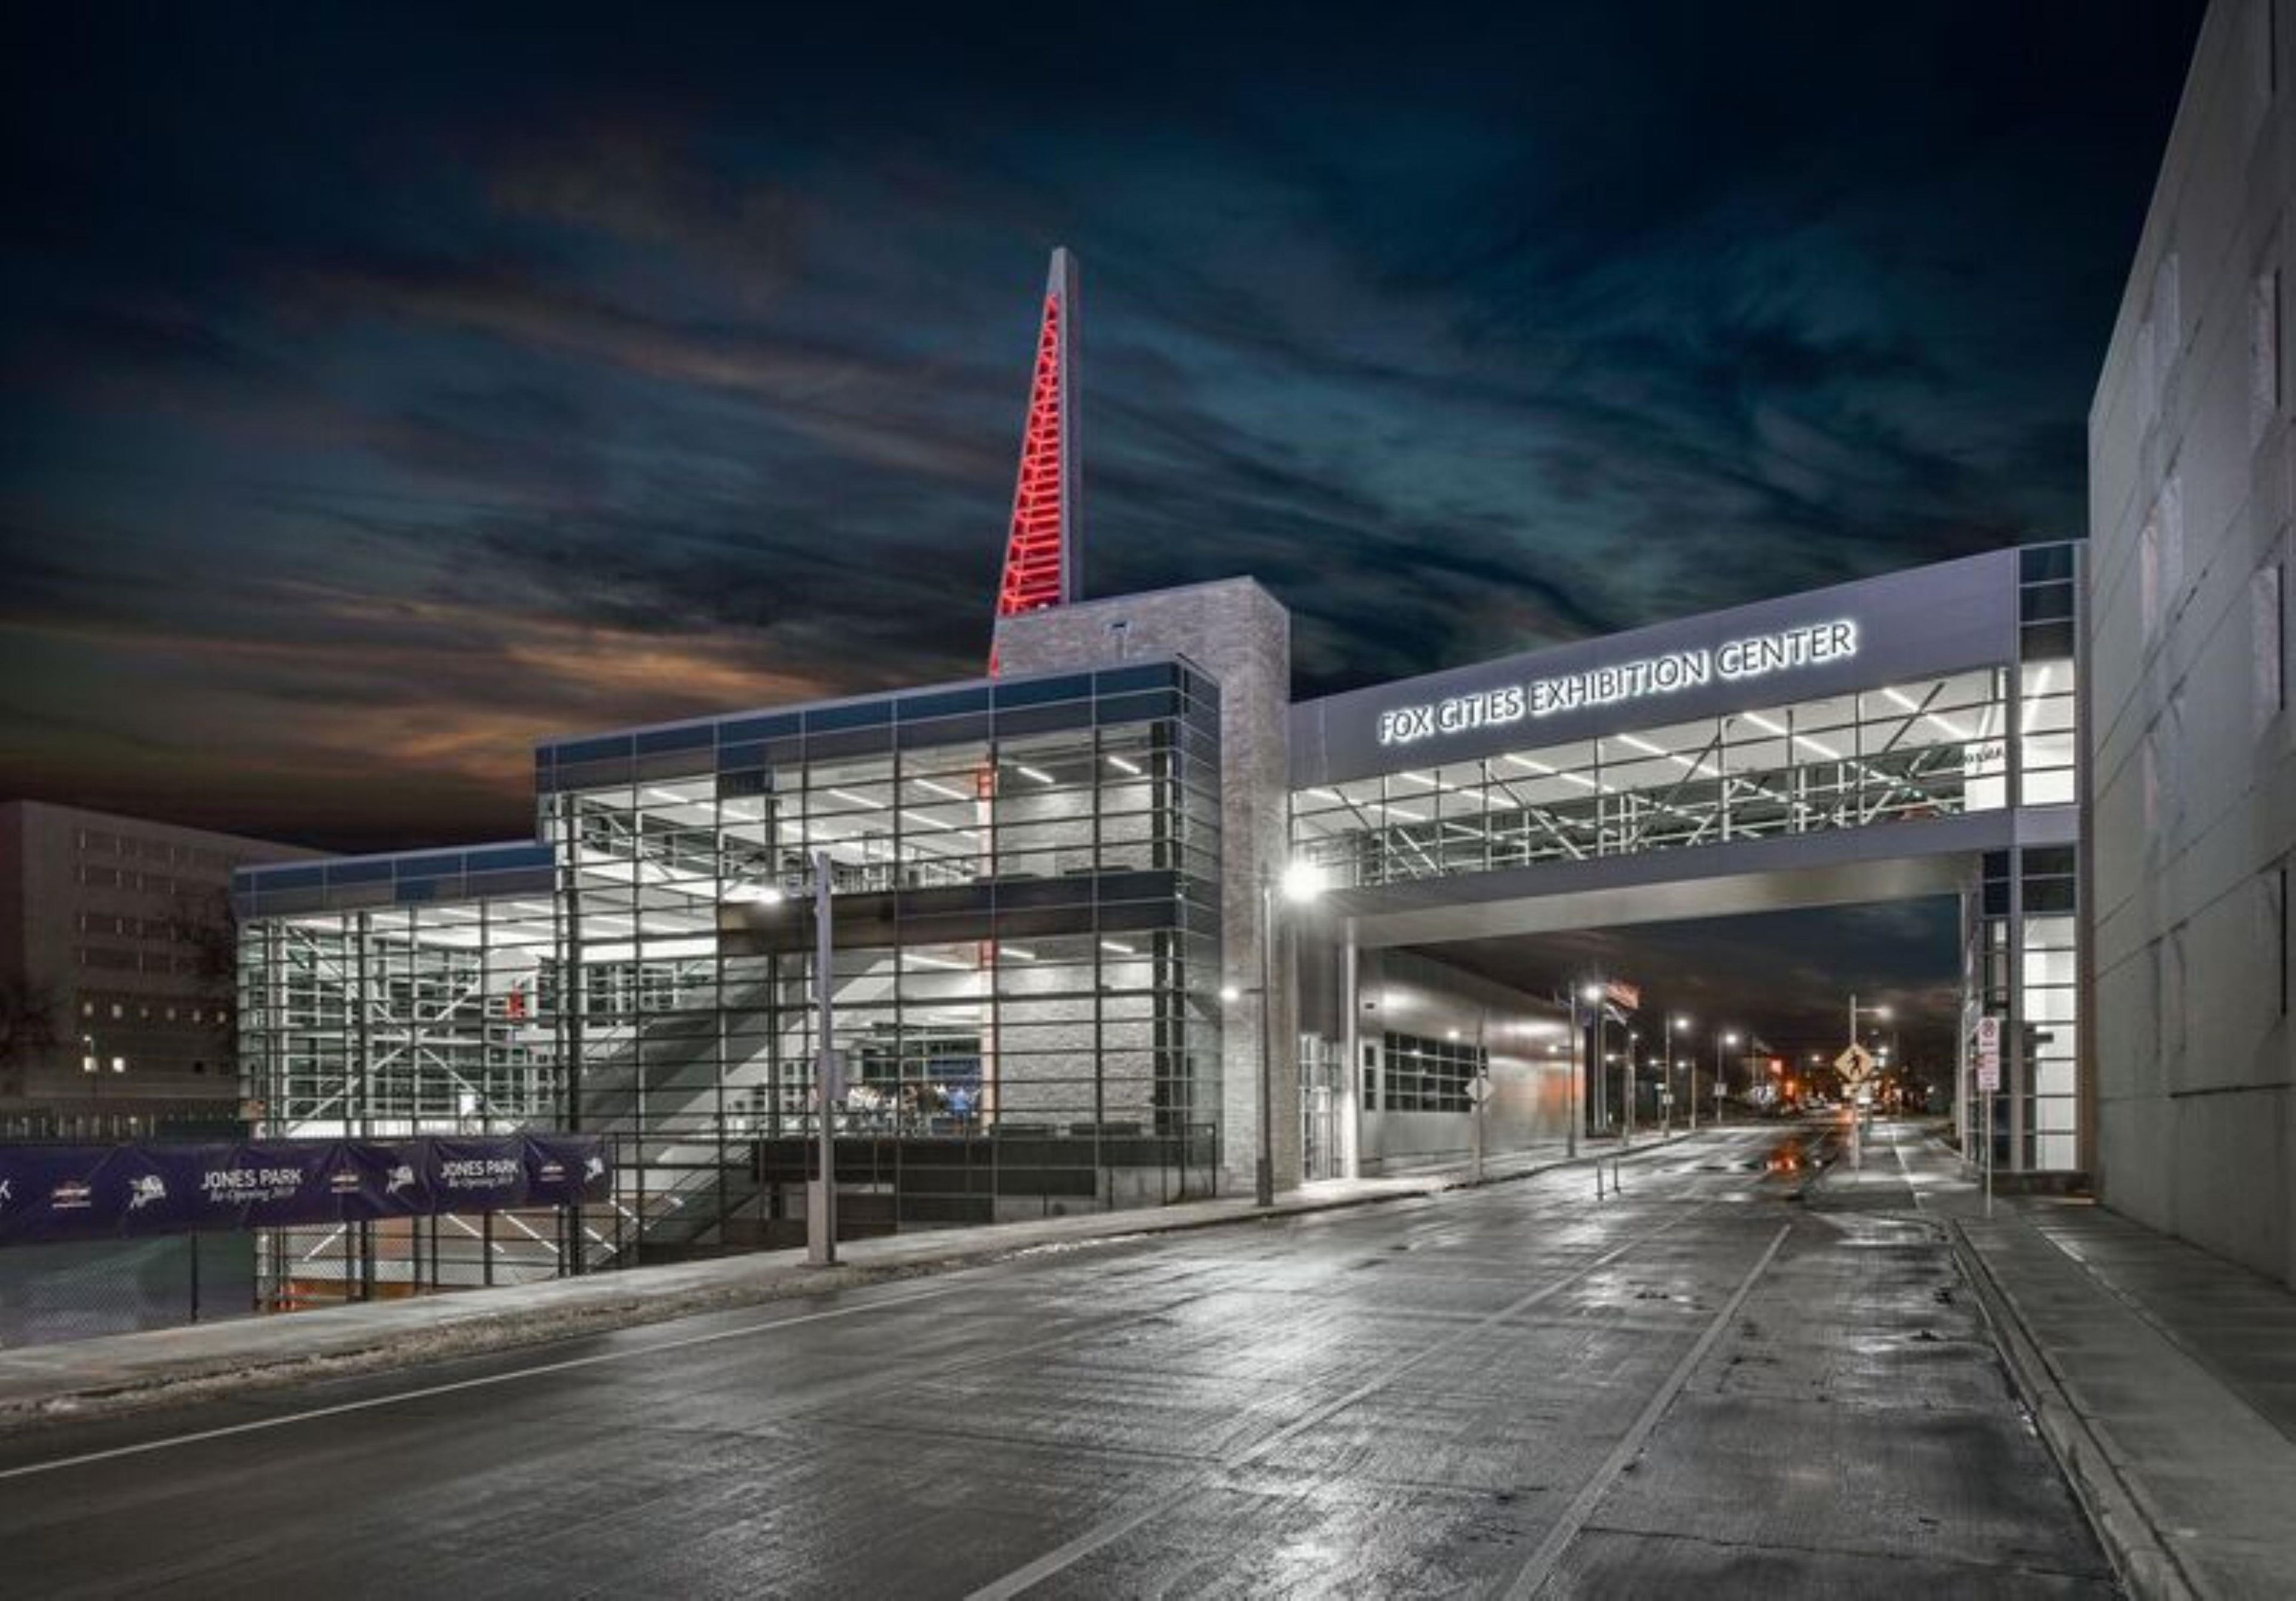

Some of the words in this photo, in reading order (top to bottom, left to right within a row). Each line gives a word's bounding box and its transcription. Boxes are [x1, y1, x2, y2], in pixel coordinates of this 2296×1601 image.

[1379, 705, 1433, 744] FOX
[1437, 687, 1524, 732] CITIES
[1528, 649, 1709, 716] EXHIBITION
[1717, 619, 1856, 679] CENTER
[200, 1169, 257, 1191] JONES
[259, 1168, 303, 1187] PARK
[440, 1160, 484, 1179] JONES
[486, 1159, 519, 1175] PARK
